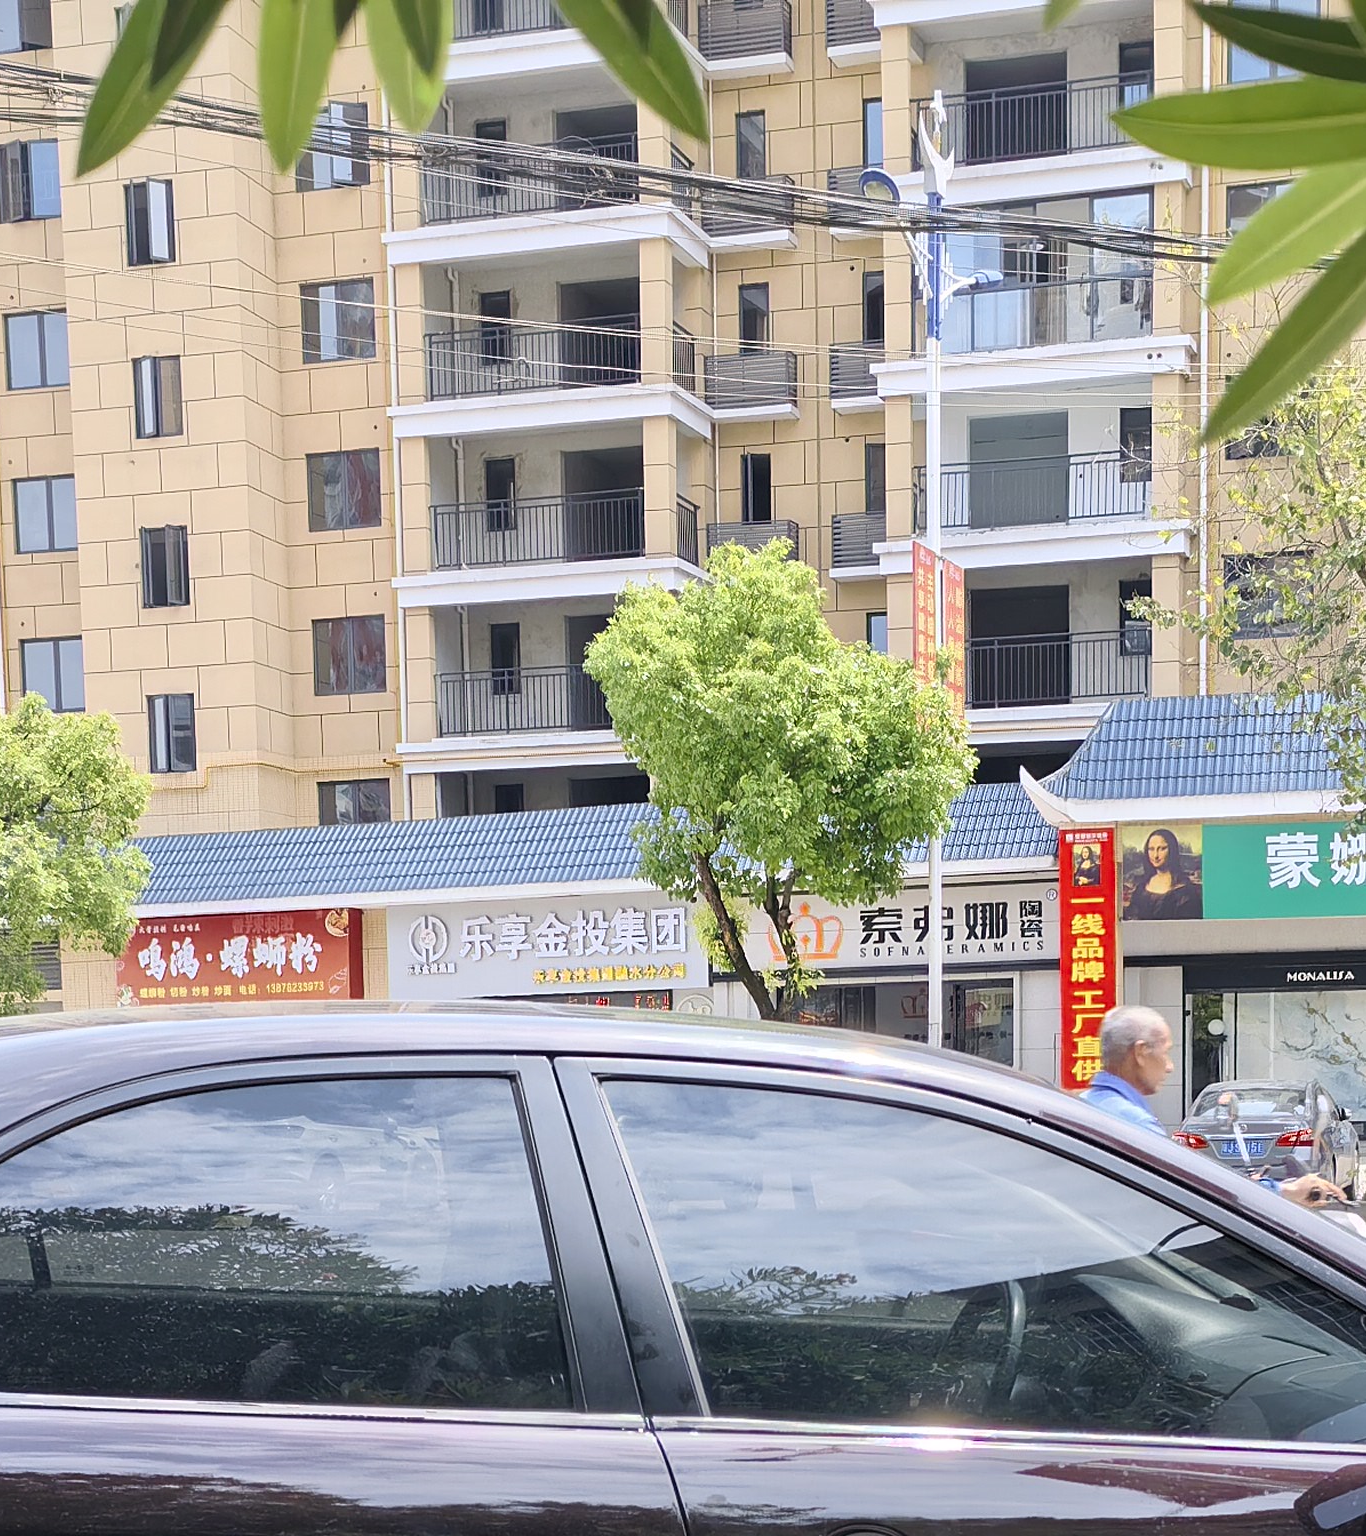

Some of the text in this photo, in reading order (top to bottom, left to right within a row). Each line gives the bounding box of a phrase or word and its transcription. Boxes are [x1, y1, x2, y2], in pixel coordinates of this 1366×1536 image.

[459, 906, 687, 962] 乐享金投集团
[860, 902, 1009, 945] 索弗娜
[1019, 900, 1042, 938] 陶瓷
[860, 940, 1044, 958] SOFNA ERAMICS
[1070, 897, 1106, 1082] 一线品牌 工厂直供
[1286, 970, 1355, 982] MONALISA
